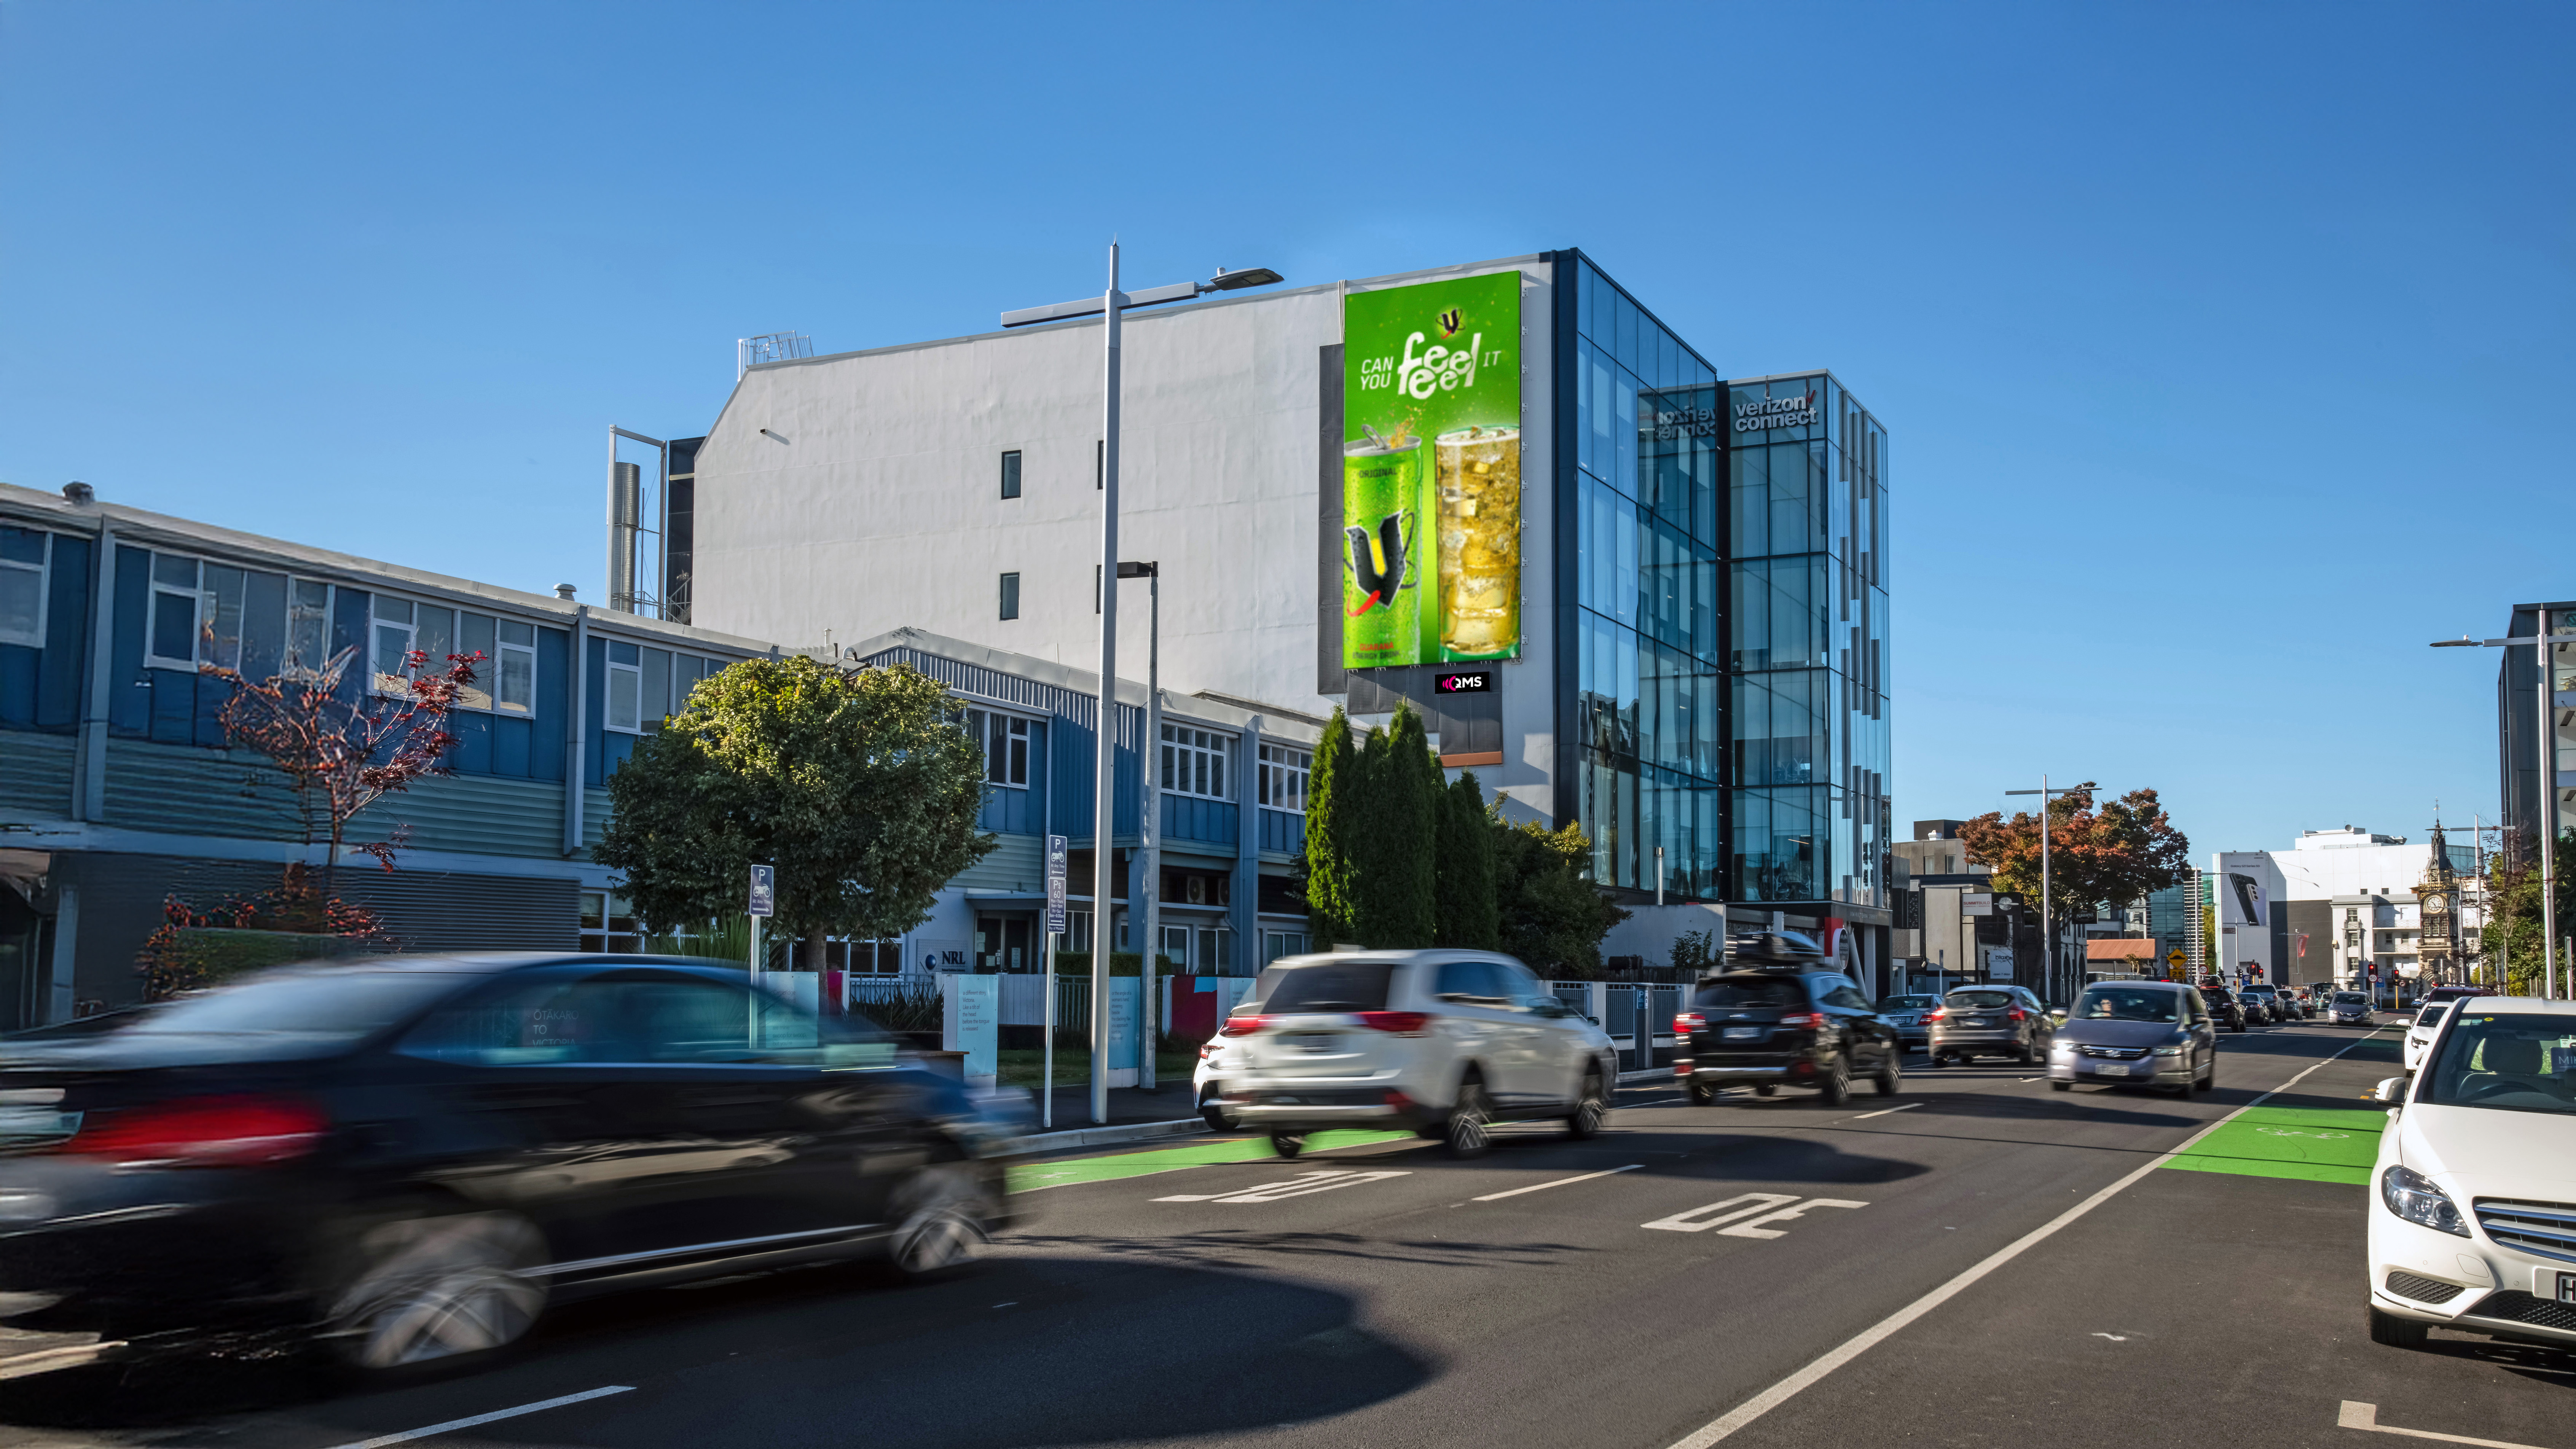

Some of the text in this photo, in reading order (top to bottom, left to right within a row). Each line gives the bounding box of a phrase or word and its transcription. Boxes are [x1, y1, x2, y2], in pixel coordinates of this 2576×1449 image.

[1361, 356, 1394, 374] CAN
[1483, 351, 1502, 367] IT
[1361, 373, 1391, 391] YOU
[1735, 396, 1806, 416] verizon
[1735, 407, 1817, 432] connect
[1359, 467, 1397, 478] ORIGINAL
[1360, 642, 1394, 651] GUARANA
[1380, 650, 1400, 659] DRINK
[1449, 676, 1482, 691] QMS
[1055, 838, 1060, 849] P
[759, 869, 765, 881] P
[942, 951, 965, 964] NRL
[534, 1009, 579, 1020] ŌTĀKARO
[533, 1025, 547, 1034] TO
[1148, 1171, 1413, 1203] 30
[2562, 1279, 2576, 1301] H
